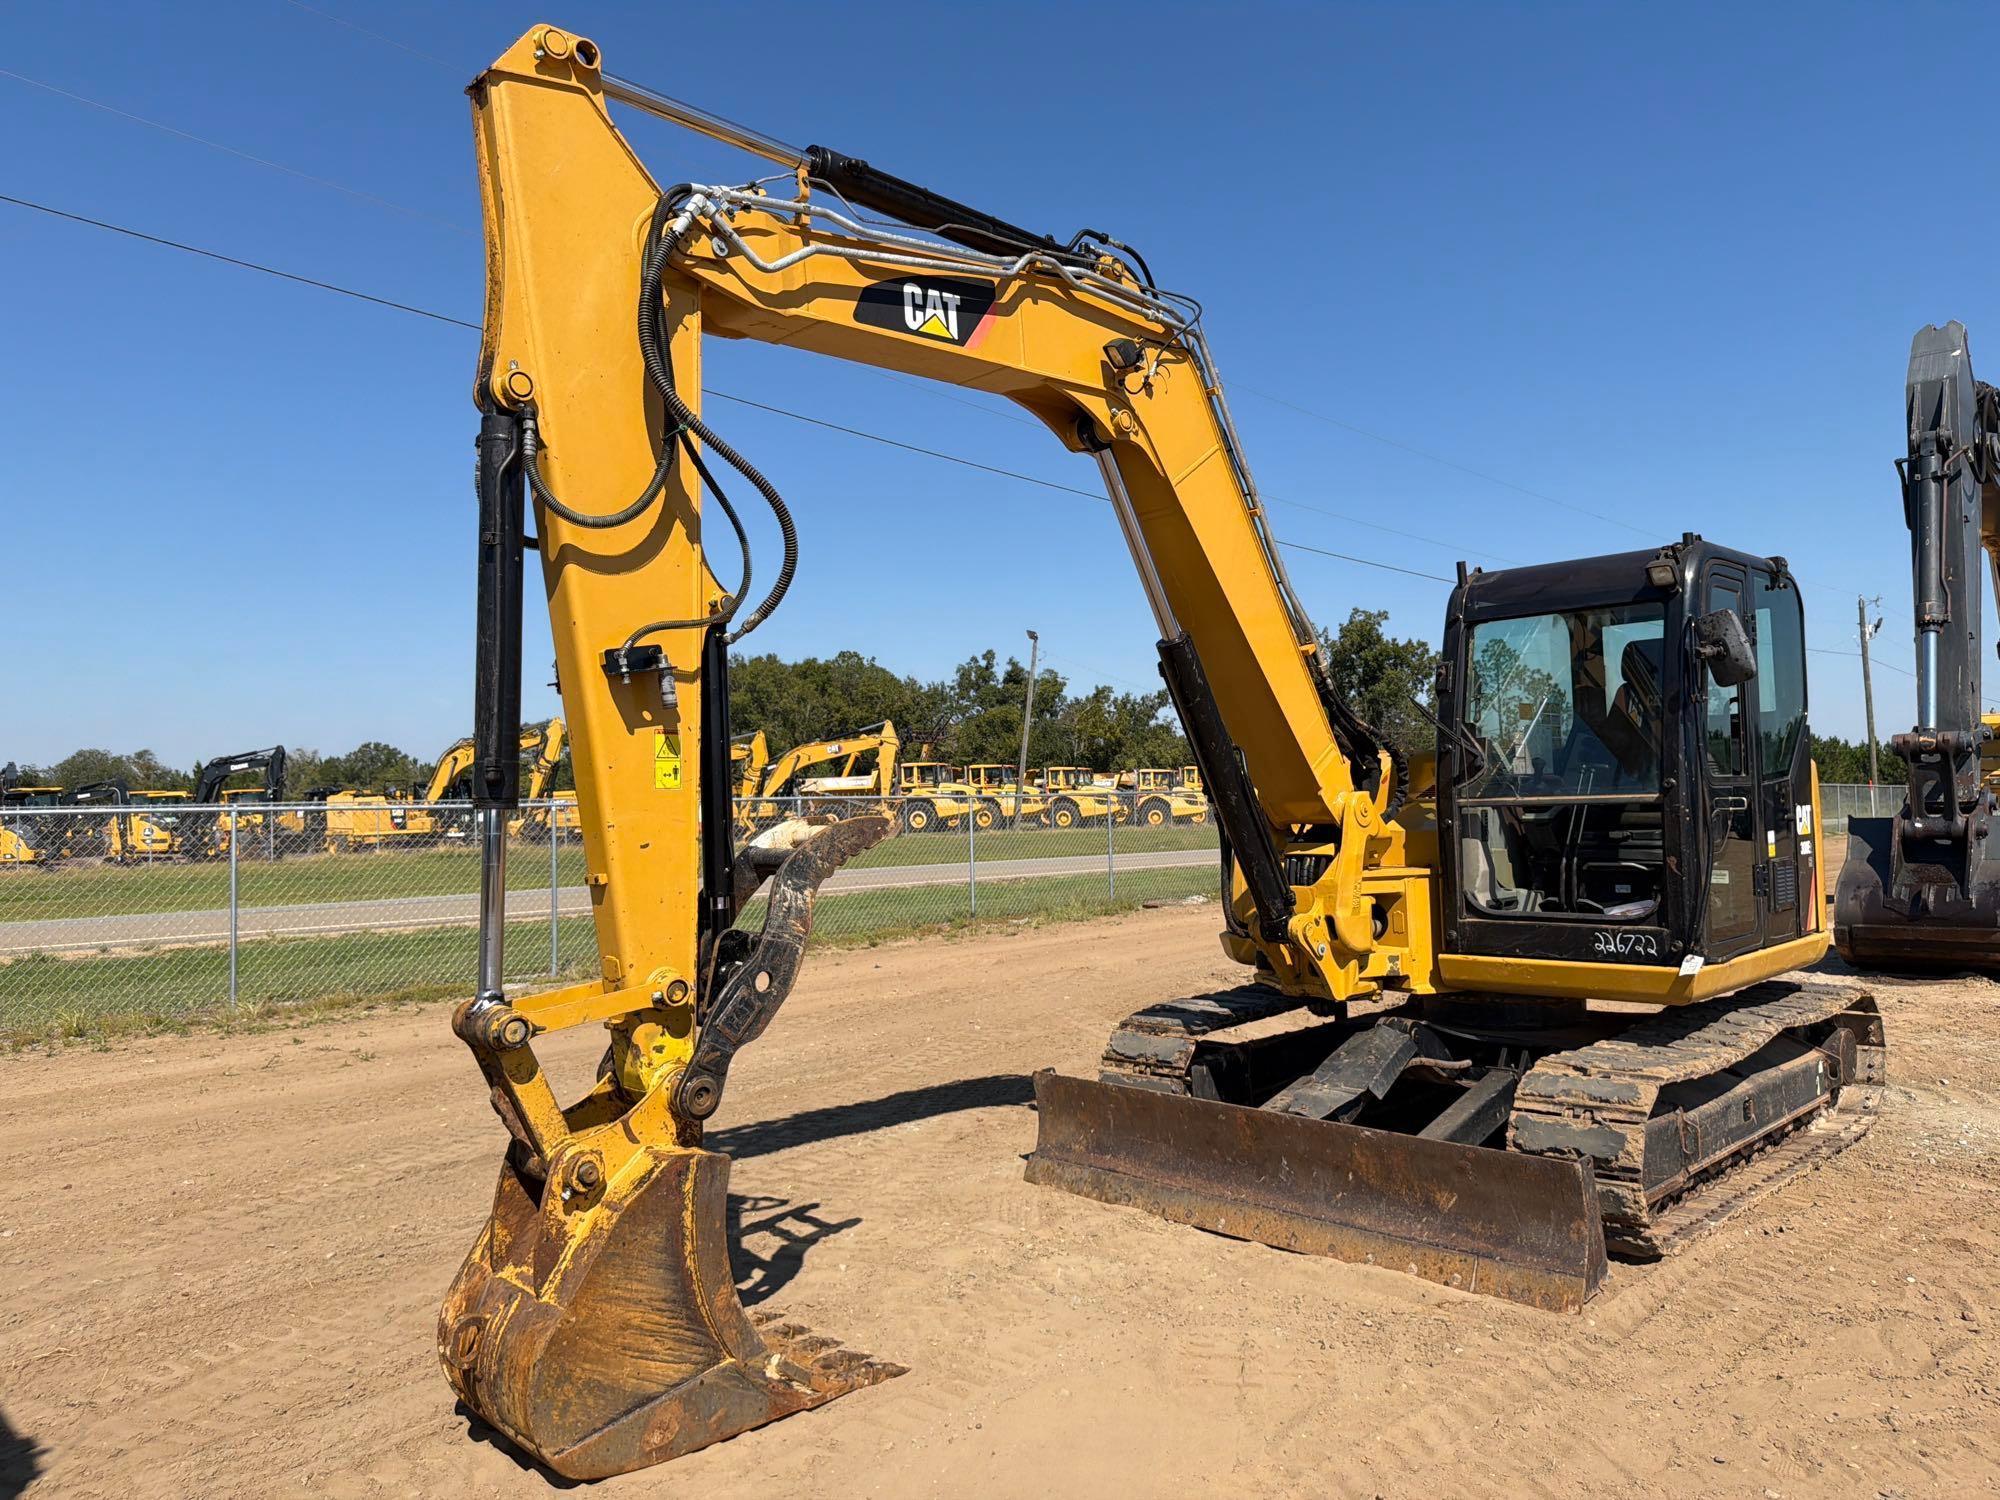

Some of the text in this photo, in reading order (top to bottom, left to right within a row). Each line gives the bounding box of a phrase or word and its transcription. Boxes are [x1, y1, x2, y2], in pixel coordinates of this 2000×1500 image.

[903, 282, 961, 341] CAT
[1796, 805, 1811, 835] CAT
[1594, 932, 1658, 957] 226722
